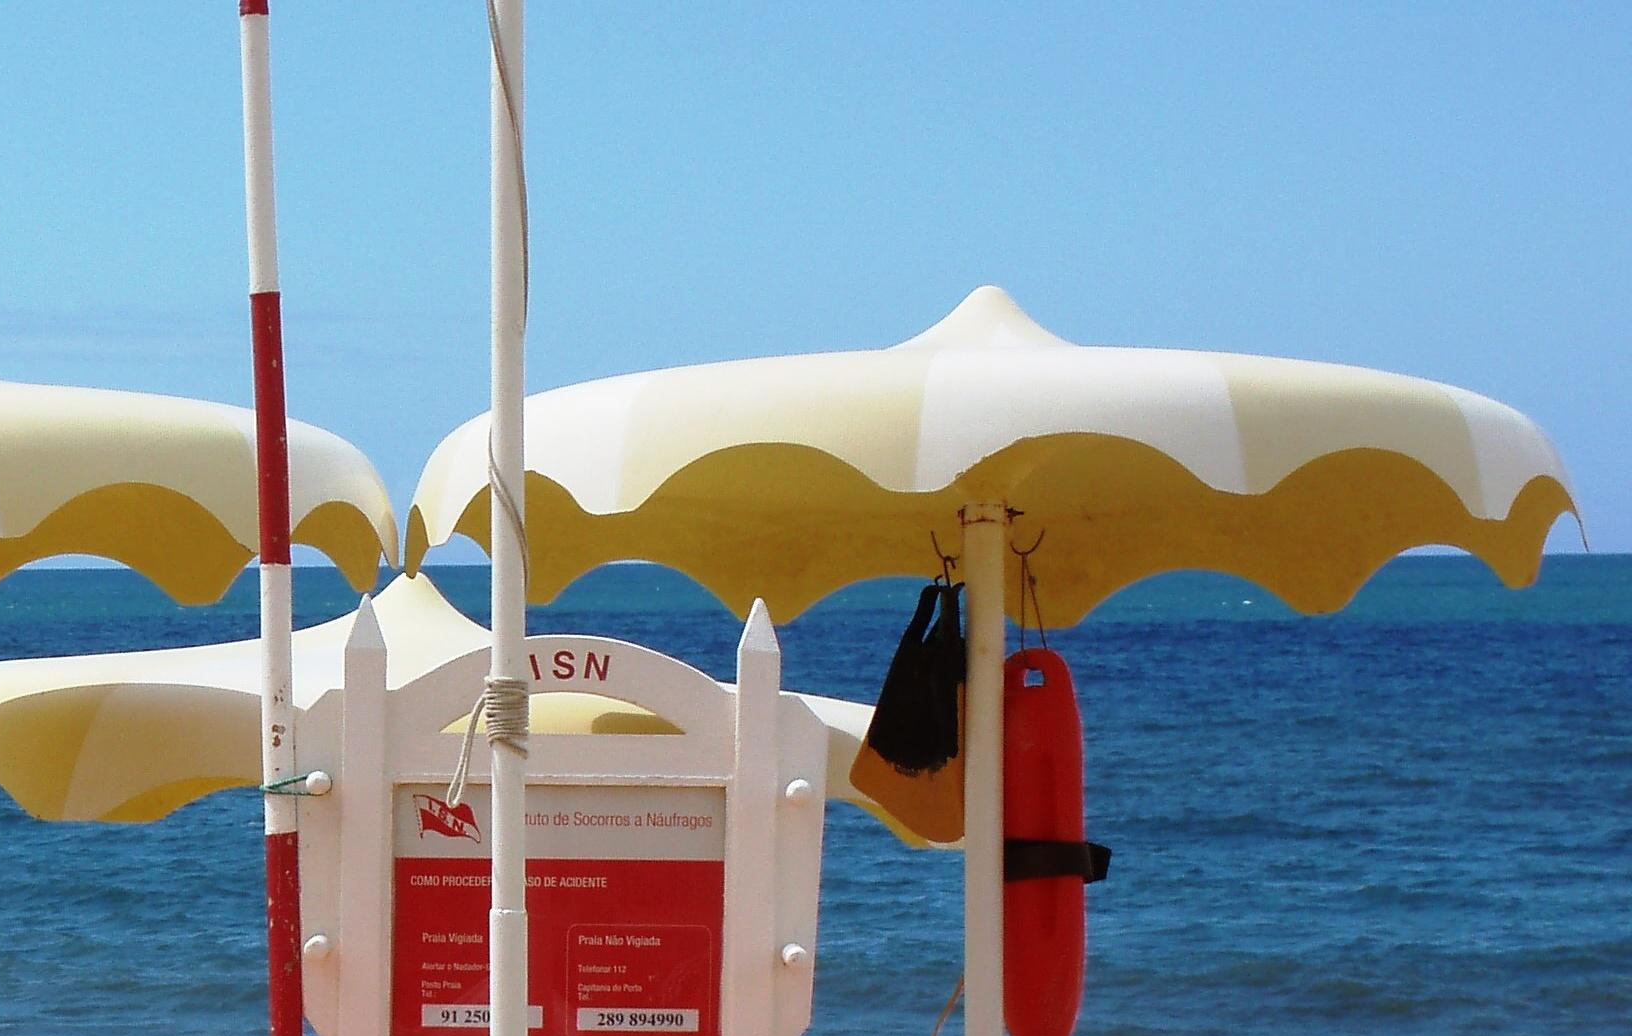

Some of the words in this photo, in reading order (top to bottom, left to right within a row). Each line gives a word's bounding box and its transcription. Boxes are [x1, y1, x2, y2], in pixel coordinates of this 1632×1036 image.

[529, 650, 610, 682] ISN
[524, 812, 549, 826] tuto
[553, 811, 569, 826] de
[573, 812, 630, 827] Socorros
[634, 815, 643, 827] a
[647, 811, 713, 830] Náufragos
[410, 876, 440, 886] COMO
[523, 876, 542, 888] ASO
[544, 877, 556, 888] DE
[559, 877, 607, 888] ACIDENTE
[422, 932, 446, 943] Praia
[448, 932, 483, 945] Vigiada
[578, 935, 602, 946] Praia
[605, 934, 624, 946] Não
[626, 935, 661, 948] Vigiada
[578, 964, 611, 973] Telefonar
[613, 965, 627, 973] 112
[442, 981, 462, 989] Praia
[578, 983, 611, 993] Capitania
[623, 984, 643, 993] Porto
[441, 1010, 457, 1024] 91
[464, 1010, 490, 1024] 250
[597, 1013, 624, 1026] 289
[629, 1013, 684, 1027] 894990
